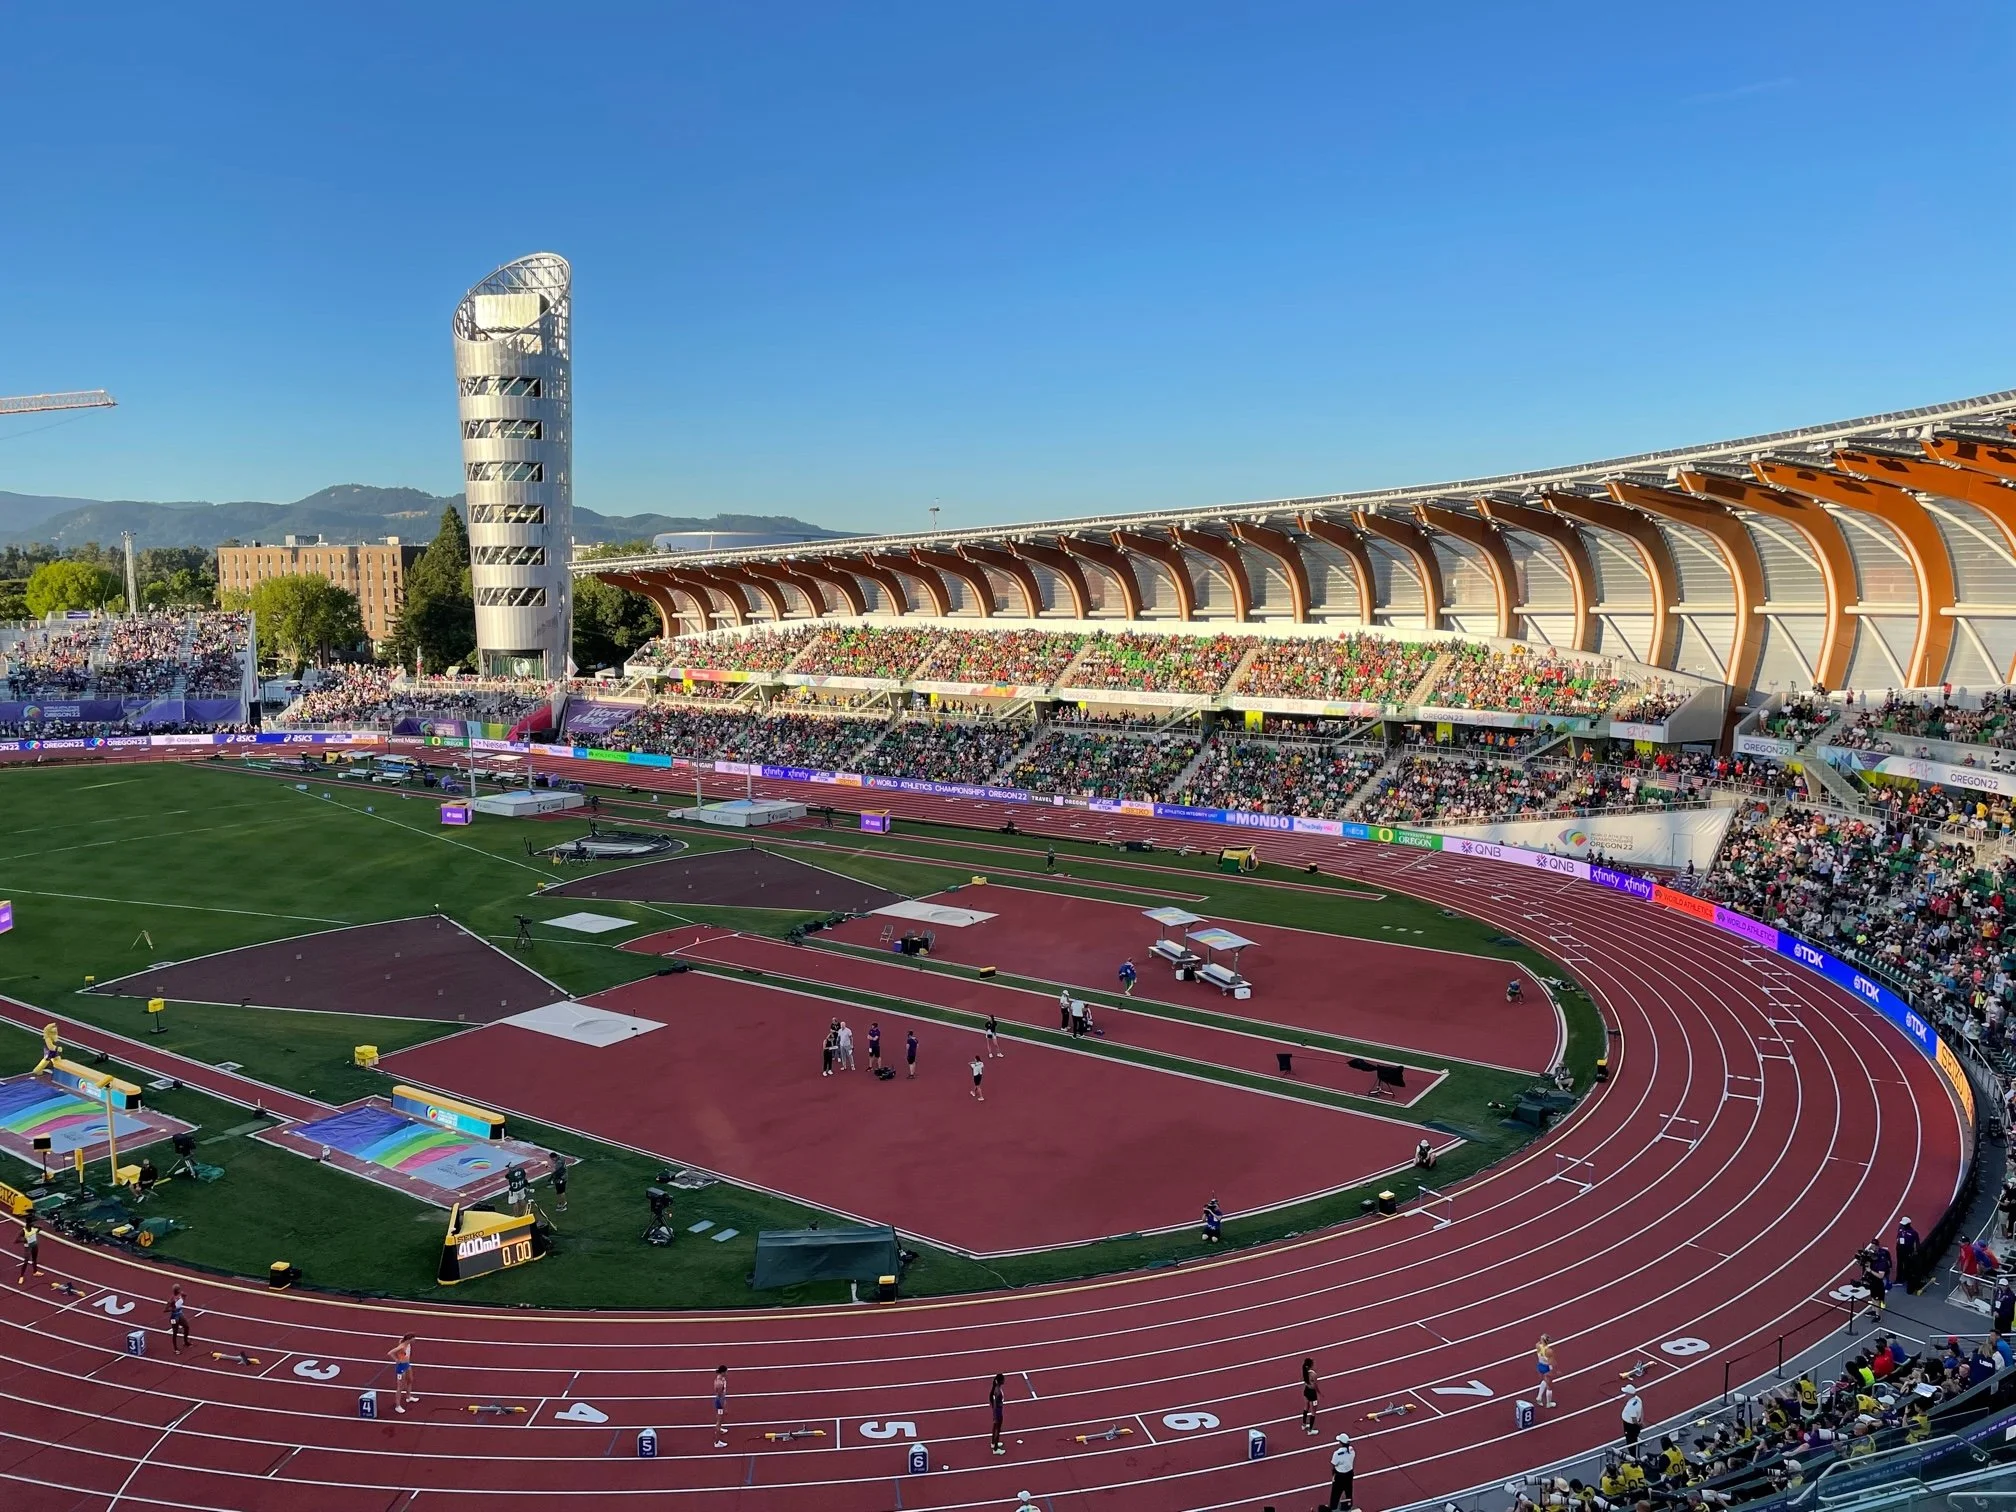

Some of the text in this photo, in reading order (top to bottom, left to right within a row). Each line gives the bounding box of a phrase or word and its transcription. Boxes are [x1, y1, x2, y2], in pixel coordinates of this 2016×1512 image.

[1423, 712, 1464, 722] OREGON22
[43, 740, 84, 749] OREGON22
[107, 738, 147, 746] OREGON22
[482, 740, 508, 749] Nielsen
[1743, 742, 1790, 756] OREGON22
[763, 766, 785, 778] xfinity
[787, 769, 809, 780] xfinity
[1950, 773, 1999, 791] OREGON22
[876, 779, 1028, 800] WORLD ATHLETICS CHAMPIONSHIPS OREGON22
[1031, 795, 1052, 803] TRAVEL
[1125, 807, 1149, 815] SEIKO
[1236, 812, 1290, 829] MONDO
[1398, 836, 1432, 847] OREGON
[1589, 840, 1634, 851] OREGON22
[1474, 844, 1501, 858] QNB
[1549, 858, 1575, 873] QNB
[1592, 867, 1651, 895] xfinity xfinity
[1663, 892, 1713, 918] WORLD ATHLETICS
[1726, 915, 1776, 943] WORLD ATHLETICS
[1800, 945, 1824, 969] TDK
[1859, 977, 1880, 1003] TDK
[1911, 1013, 1927, 1043] TDK
[457, 1231, 485, 1243] SEIKO
[459, 1232, 501, 1257] 400mH
[502, 1241, 532, 1266] 0.00
[92, 1295, 135, 1315] 2
[129, 1339, 136, 1350] 3
[1660, 1337, 1711, 1356] 8
[293, 1359, 341, 1380] 3
[1979, 1359, 1993, 1368] USA
[1431, 1380, 1494, 1397] 7
[362, 1401, 372, 1413] 4
[554, 1402, 609, 1424] 4
[1162, 1411, 1221, 1431] 6
[1524, 1410, 1532, 1422] 8
[859, 1421, 917, 1439] 5
[642, 1440, 652, 1452] 5
[1254, 1440, 1263, 1453] 7
[913, 1455, 924, 1468] 6
